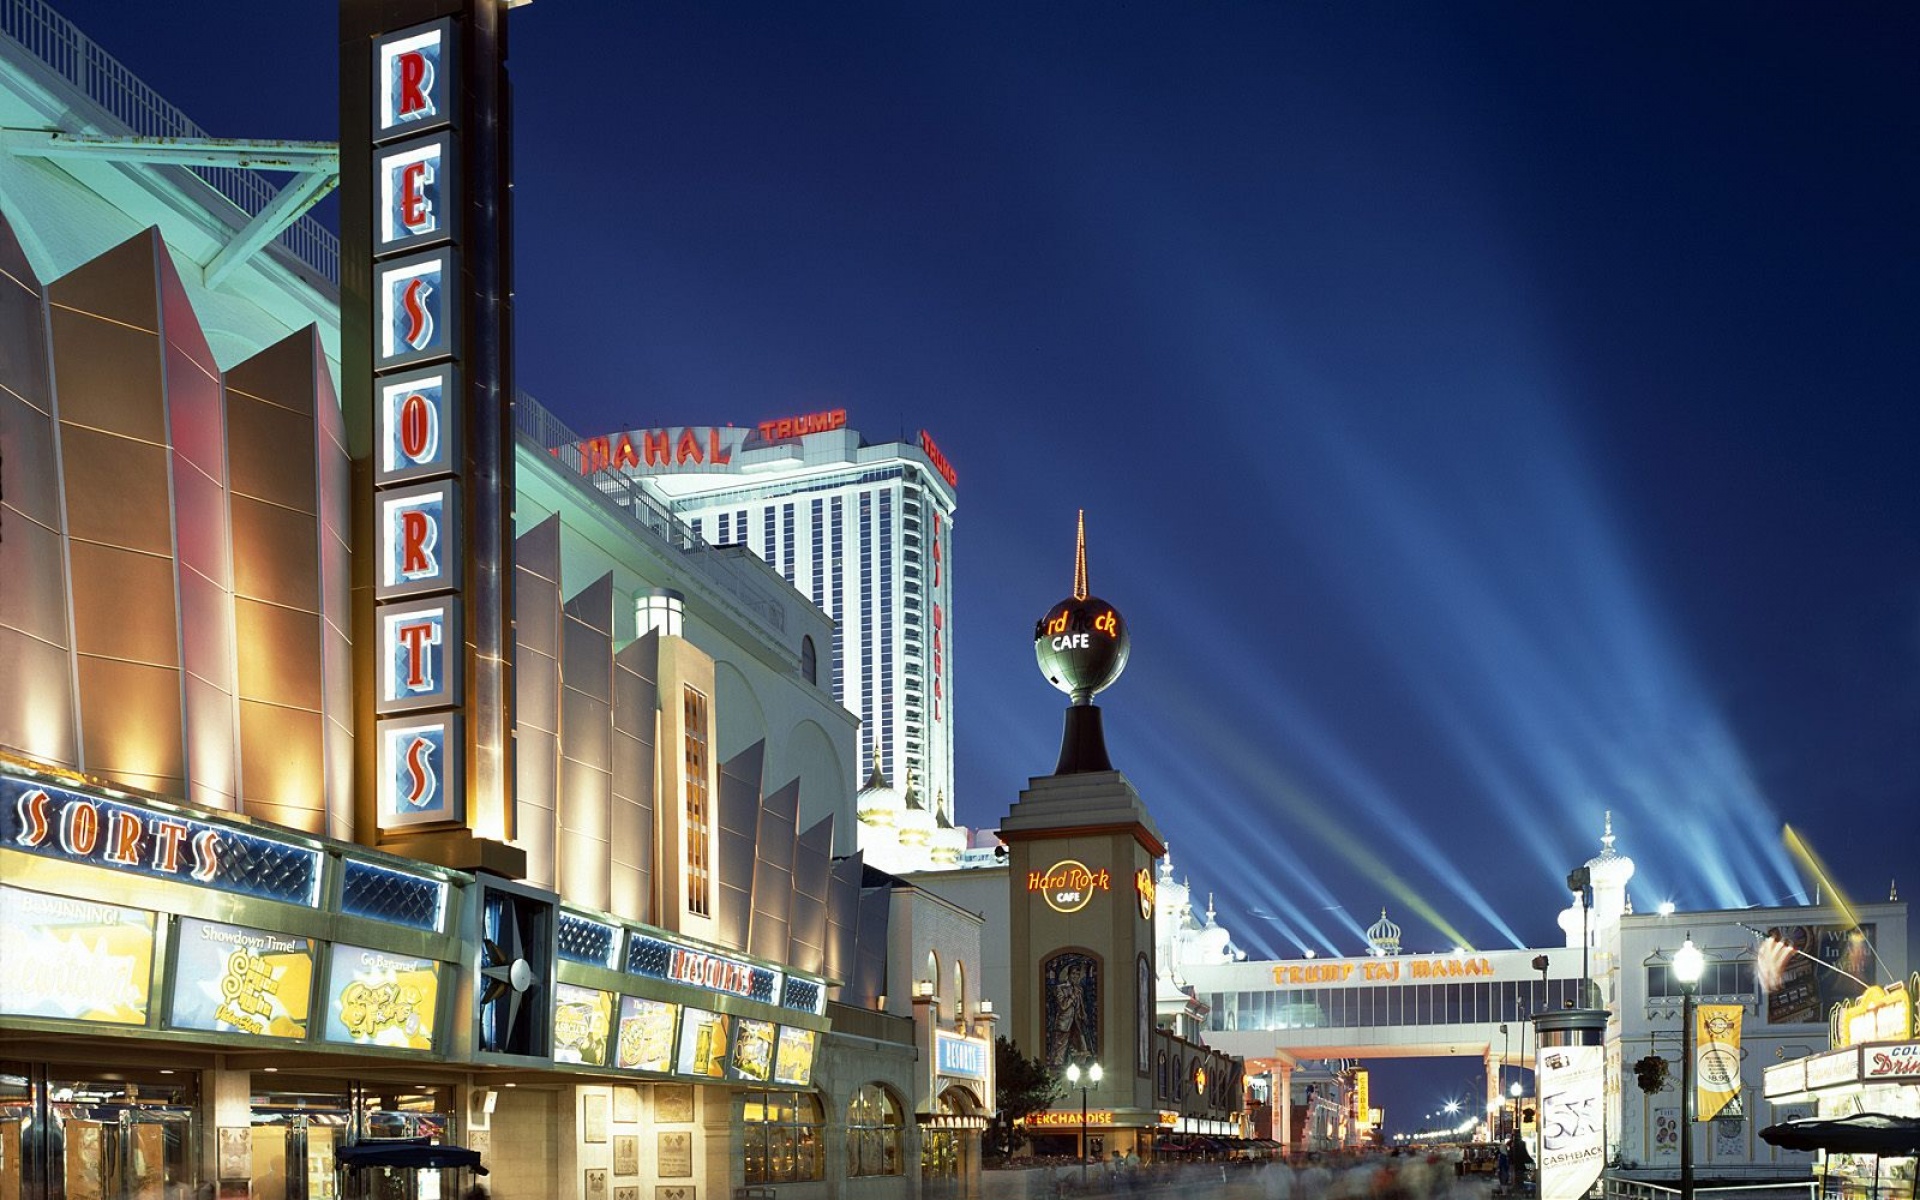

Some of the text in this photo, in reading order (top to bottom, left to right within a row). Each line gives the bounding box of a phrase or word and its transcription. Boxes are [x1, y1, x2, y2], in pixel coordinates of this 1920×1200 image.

[398, 50, 439, 807] RESORTS
[759, 408, 846, 441] TRUMP
[580, 427, 731, 476] MAHAL
[921, 429, 957, 487] TRUMP
[1051, 633, 1090, 652] CAFE
[16, 789, 219, 883] SORTS
[1028, 868, 1110, 891] Hard Rock
[1056, 892, 1080, 903] CAFE
[201, 924, 296, 954] Showdown Time!
[360, 952, 418, 972] Go Bananas!
[1272, 958, 1494, 985] TRUMP TAJ MAHAL
[946, 1041, 977, 1073] RESORTS
[1542, 1145, 1604, 1166] CASHBACK
